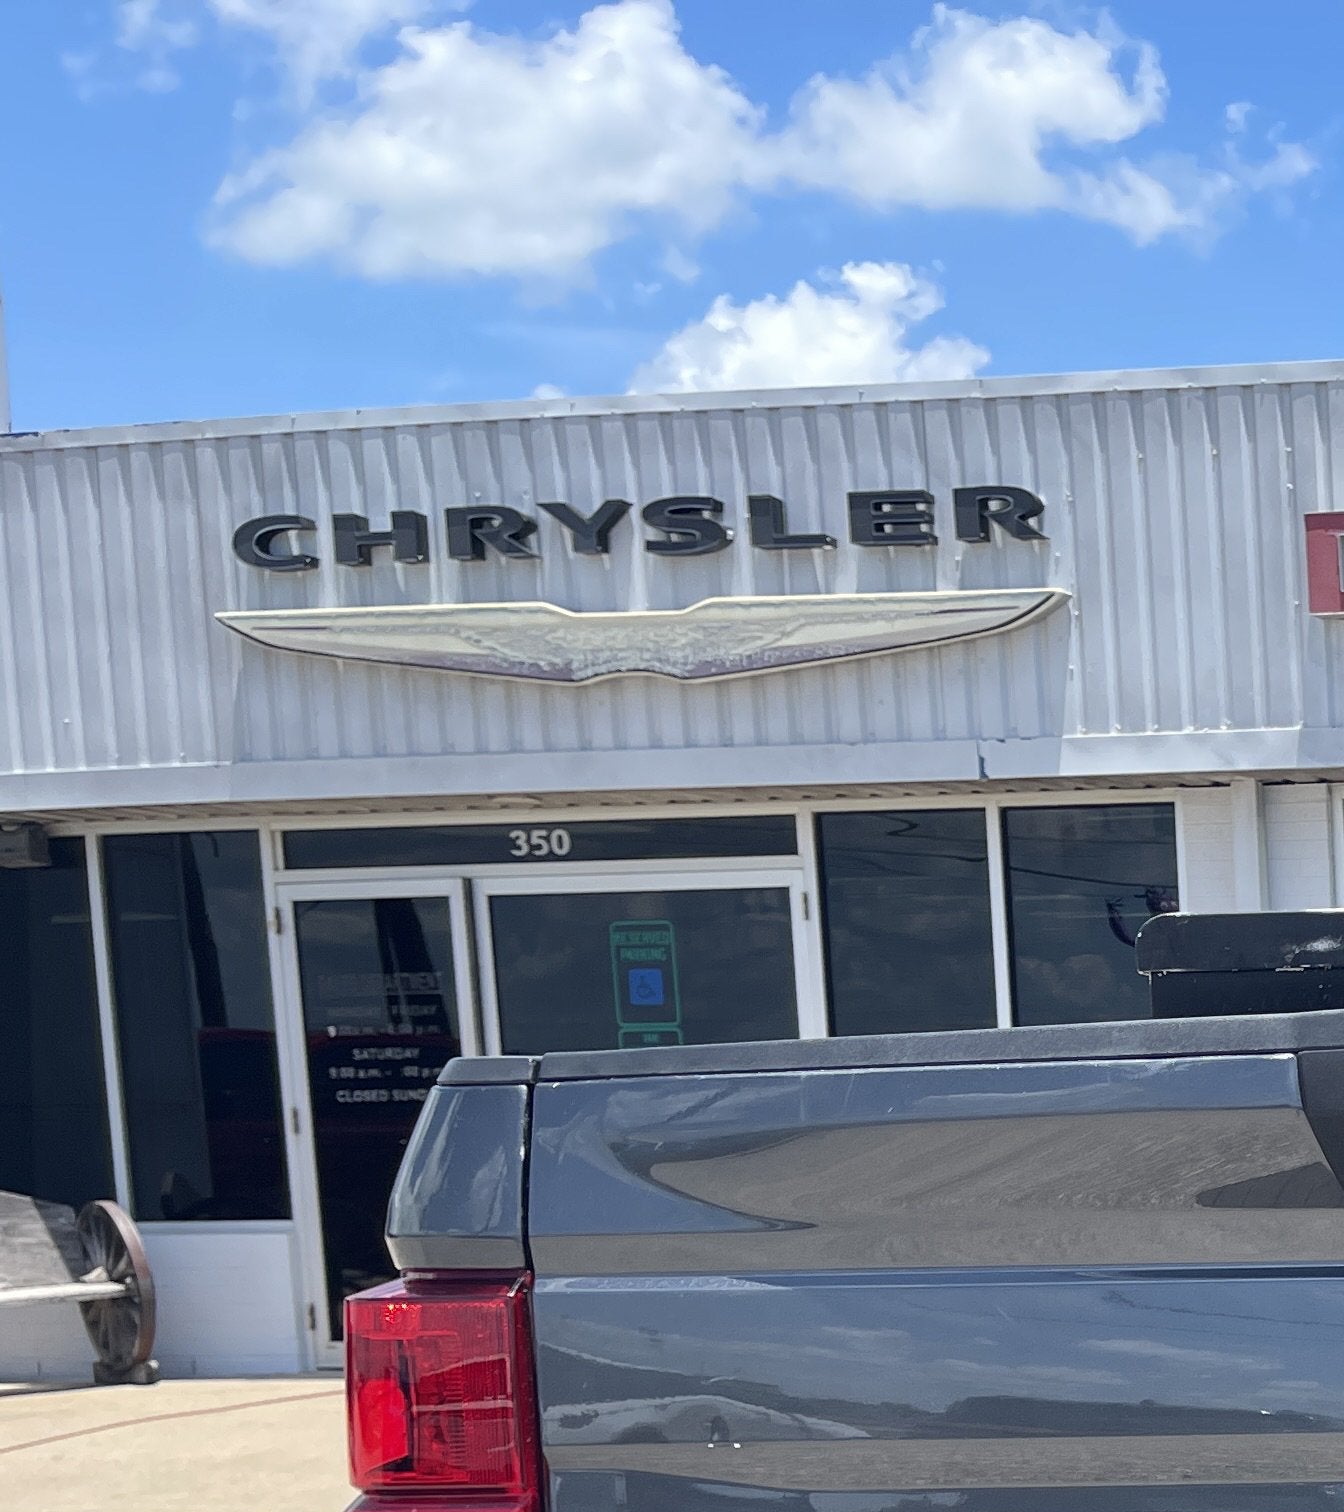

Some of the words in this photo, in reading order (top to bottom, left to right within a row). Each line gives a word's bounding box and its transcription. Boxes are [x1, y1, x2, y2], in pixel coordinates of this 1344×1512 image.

[232, 485, 1049, 573] CHRYSLER
[508, 828, 571, 857] 350
[352, 1047, 420, 1060] SATURDAY
[335, 1088, 390, 1103] CLOSED
